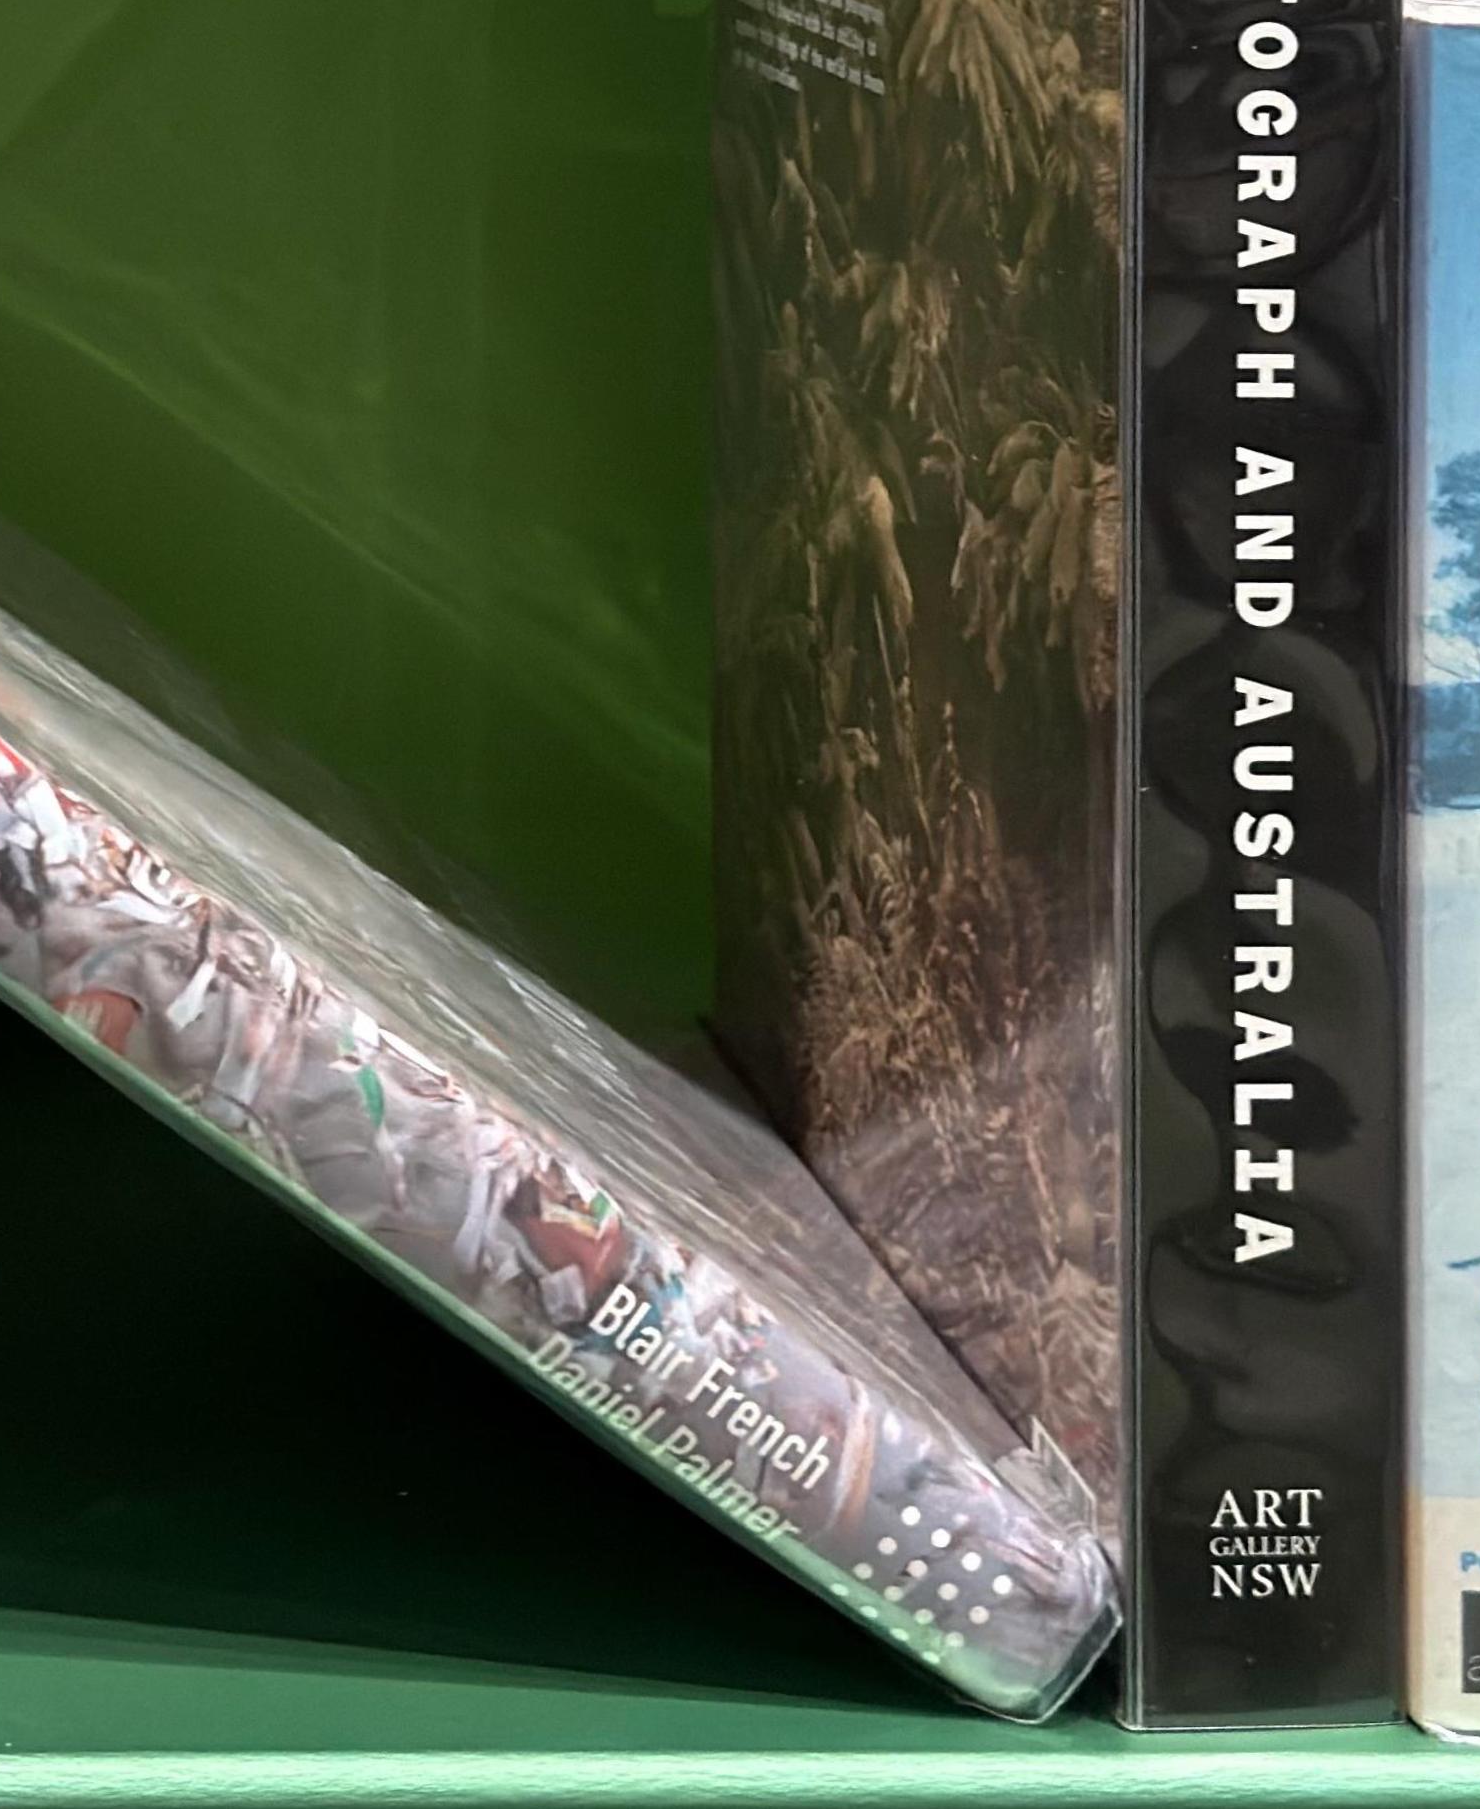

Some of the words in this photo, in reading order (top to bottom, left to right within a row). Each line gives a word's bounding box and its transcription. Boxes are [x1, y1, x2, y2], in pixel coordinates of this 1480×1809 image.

[1233, 446, 1295, 627] AND
[1232, 679, 1295, 1263] AUSTRALIA
[526, 1331, 647, 1443] Daniel
[651, 1422, 803, 1545] Palmer
[590, 1285, 694, 1379] Blair
[688, 1354, 833, 1490] French
[1209, 1535, 1321, 1557] GALLERY
[1211, 1563, 1321, 1596] NSW
[1213, 1488, 1322, 1527] ART
